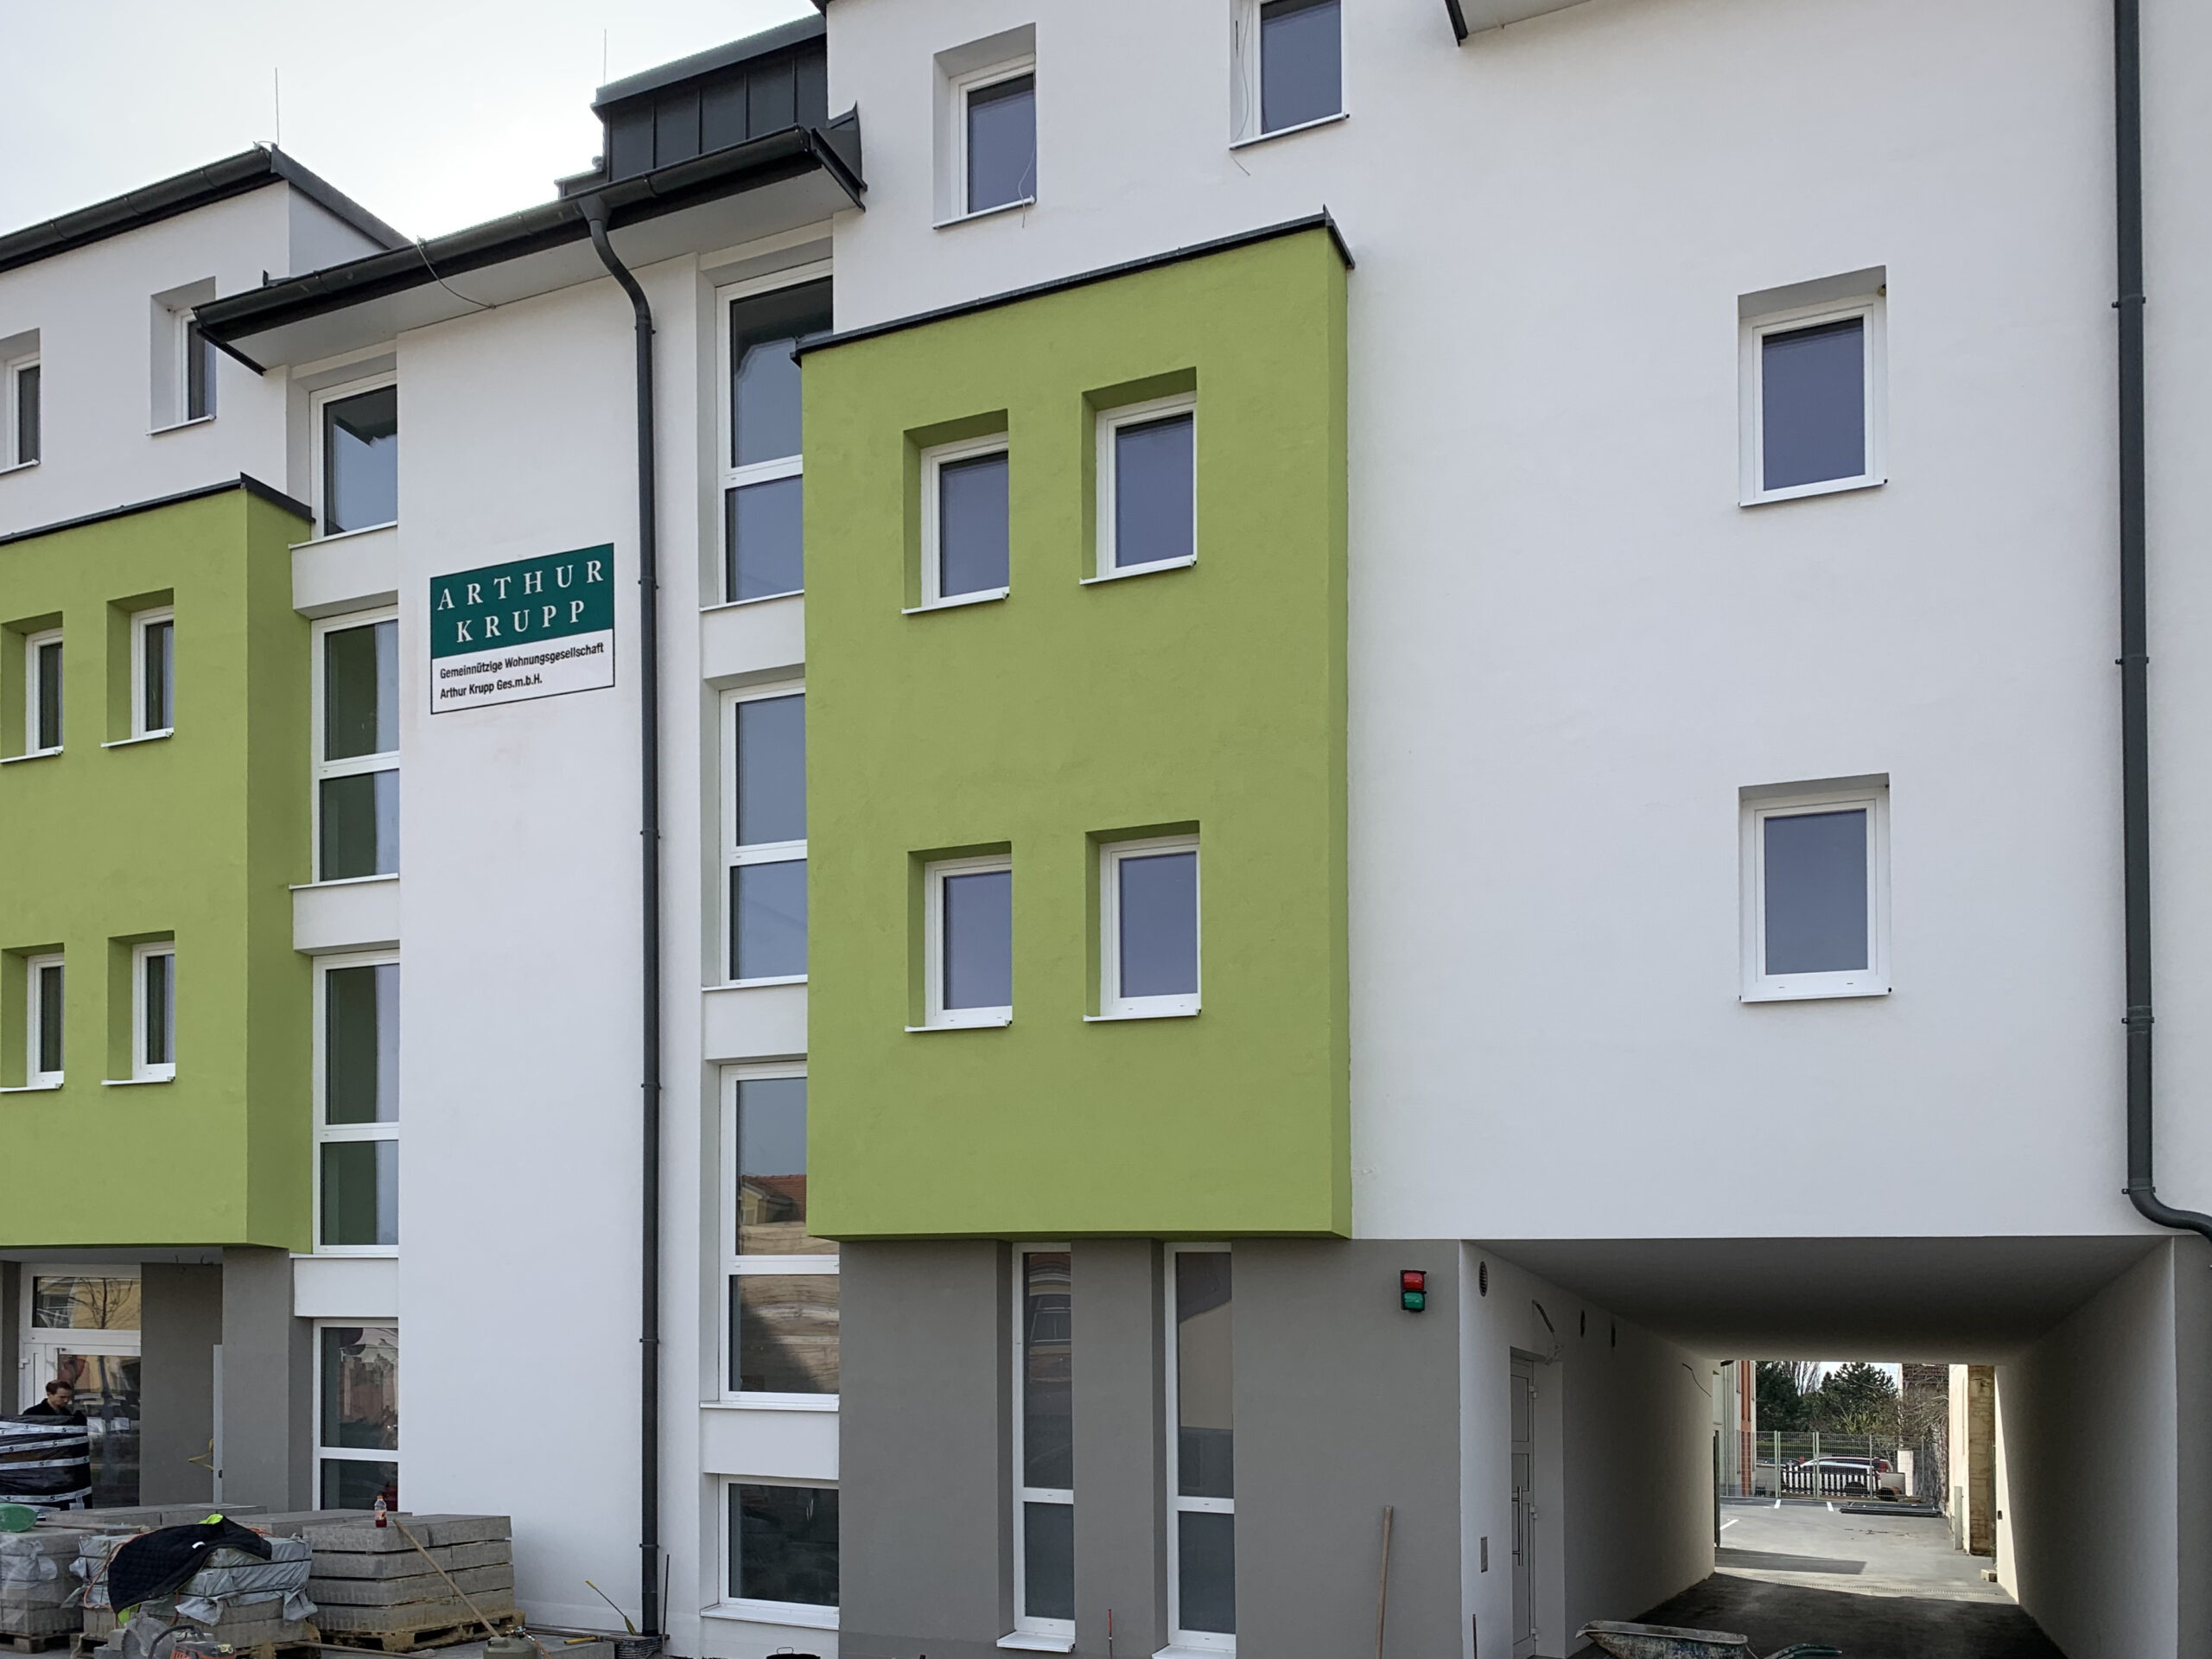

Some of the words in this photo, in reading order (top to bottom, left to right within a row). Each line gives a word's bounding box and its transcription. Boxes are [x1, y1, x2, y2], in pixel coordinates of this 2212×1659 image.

[436, 560, 603, 611] ARTHUR
[456, 600, 585, 644] KRUPP
[440, 660, 503, 679] Gemeinnützige
[505, 642, 604, 669] Wohnungsgesellschaft
[440, 686, 467, 700] Arthur
[468, 683, 494, 695] Krupp
[496, 673, 543, 690] Ges.m.b.H.
